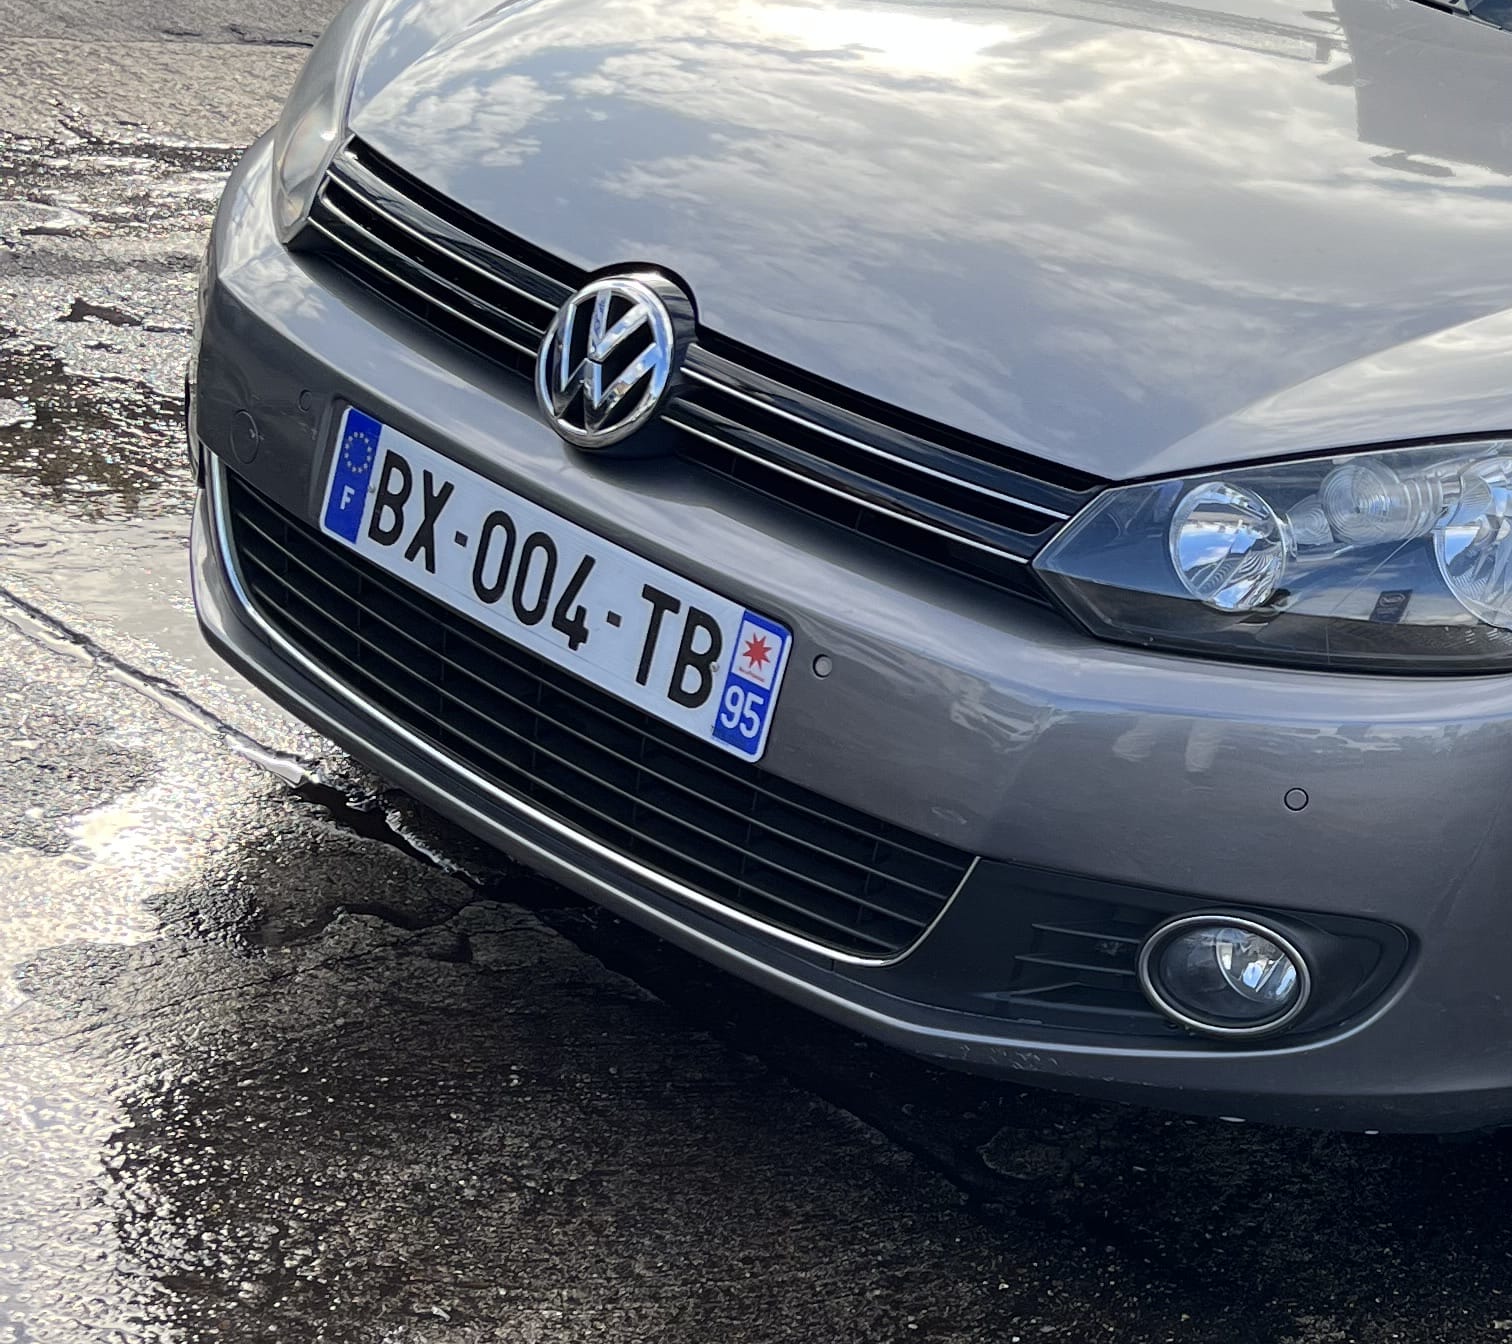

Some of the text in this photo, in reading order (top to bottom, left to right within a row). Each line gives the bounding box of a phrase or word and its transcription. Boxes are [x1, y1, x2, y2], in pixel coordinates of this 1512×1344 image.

[339, 485, 356, 511] F
[367, 448, 724, 709] BX-004-TB
[719, 683, 766, 740] 95
